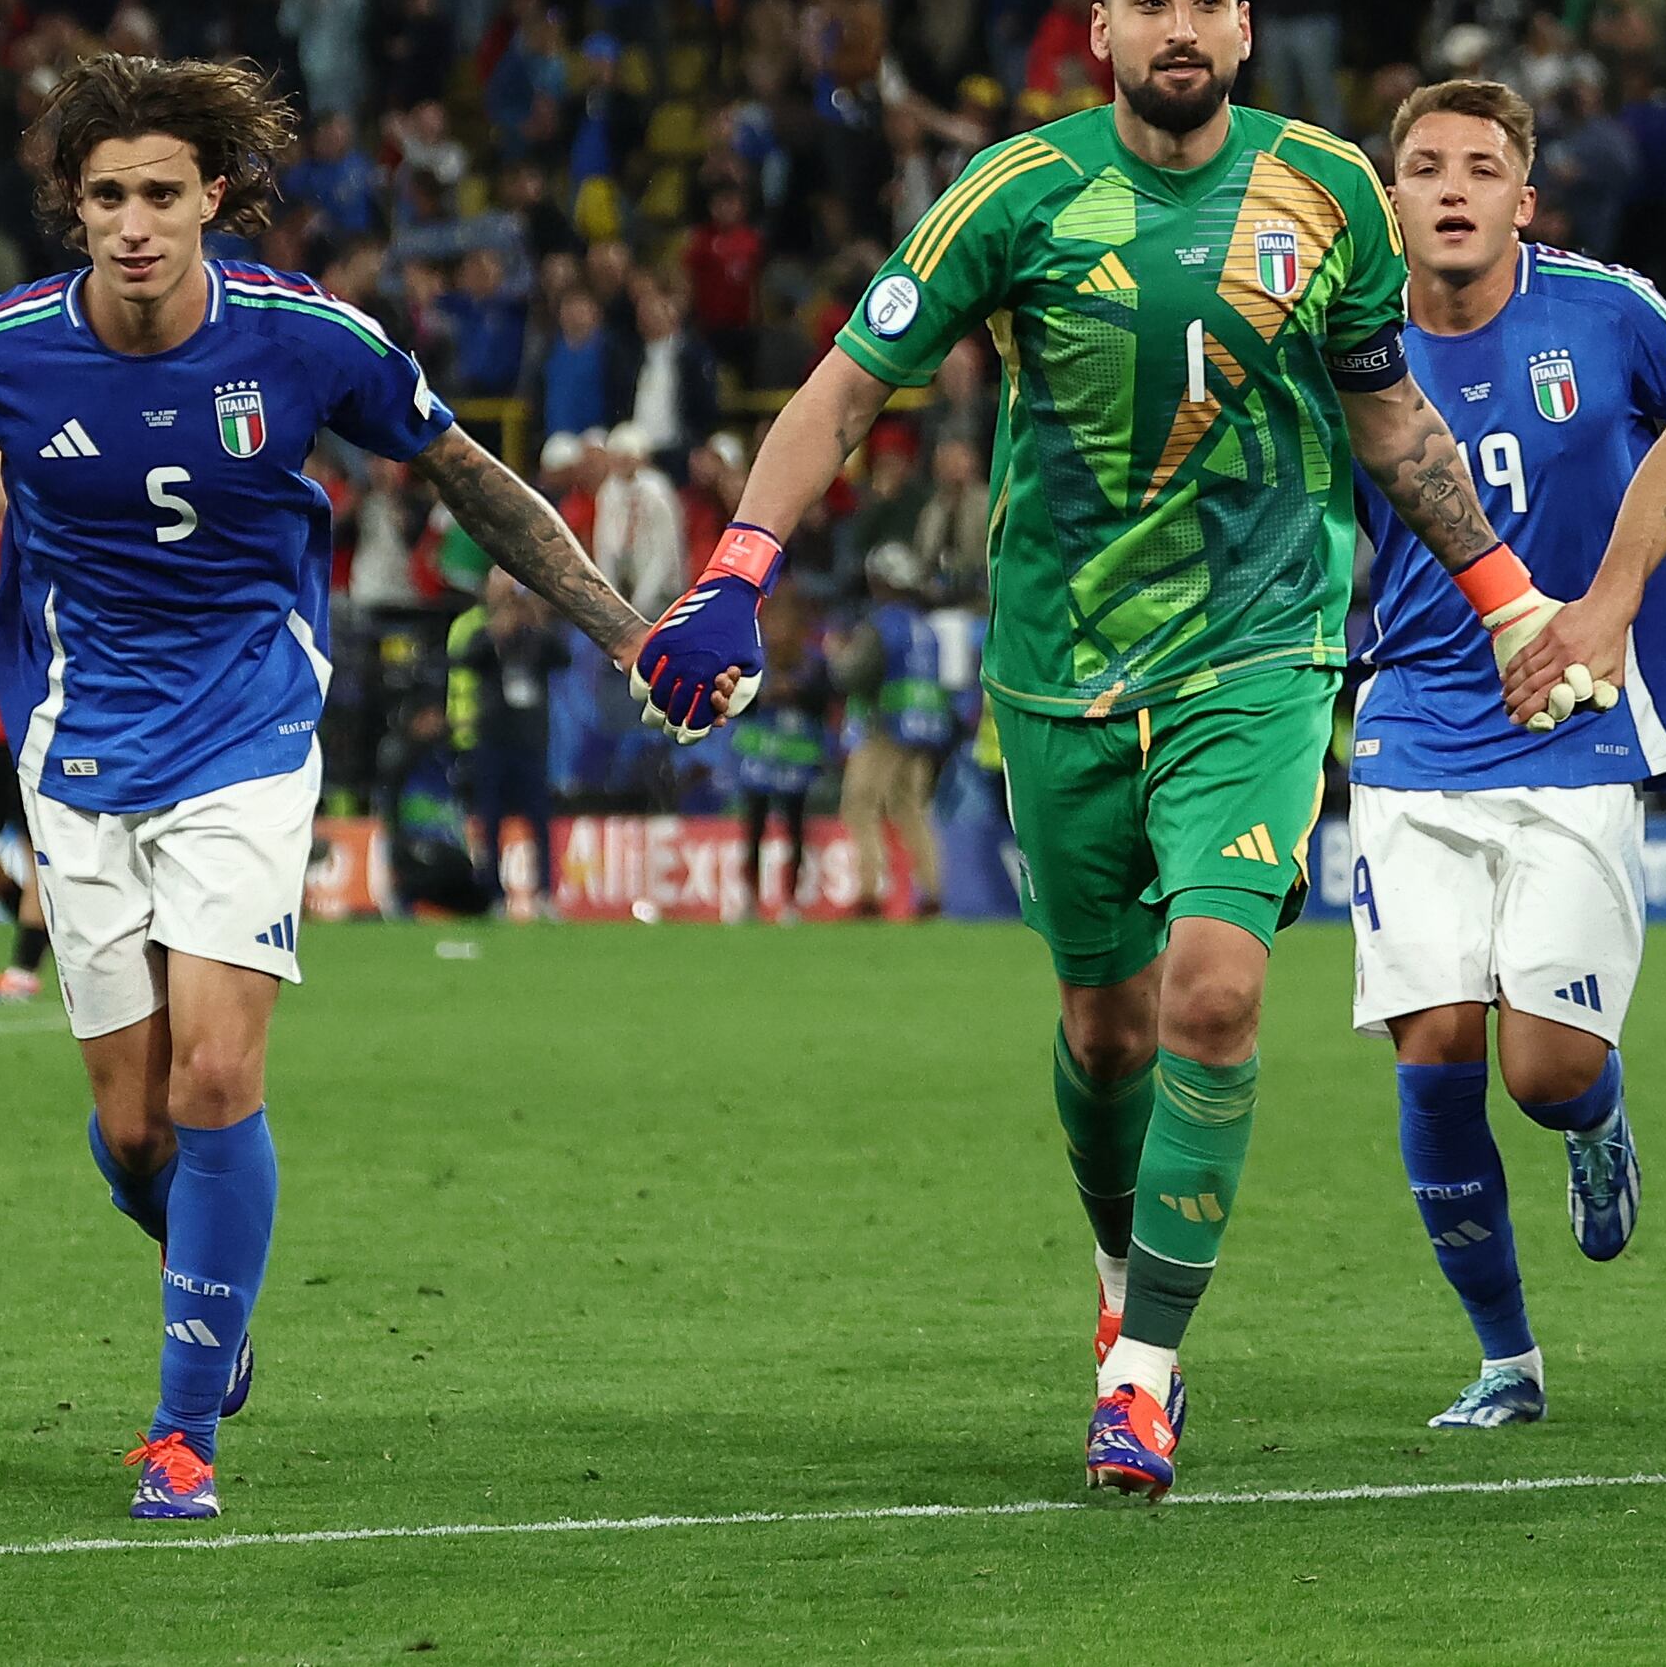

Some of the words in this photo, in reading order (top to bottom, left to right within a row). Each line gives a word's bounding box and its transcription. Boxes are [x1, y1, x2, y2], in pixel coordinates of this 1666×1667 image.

[1259, 236, 1293, 249] ITALIA
[1186, 319, 1205, 403] 1
[1534, 364, 1569, 381] ITALIA
[220, 397, 258, 413] ITALIA
[145, 466, 198, 543] 5
